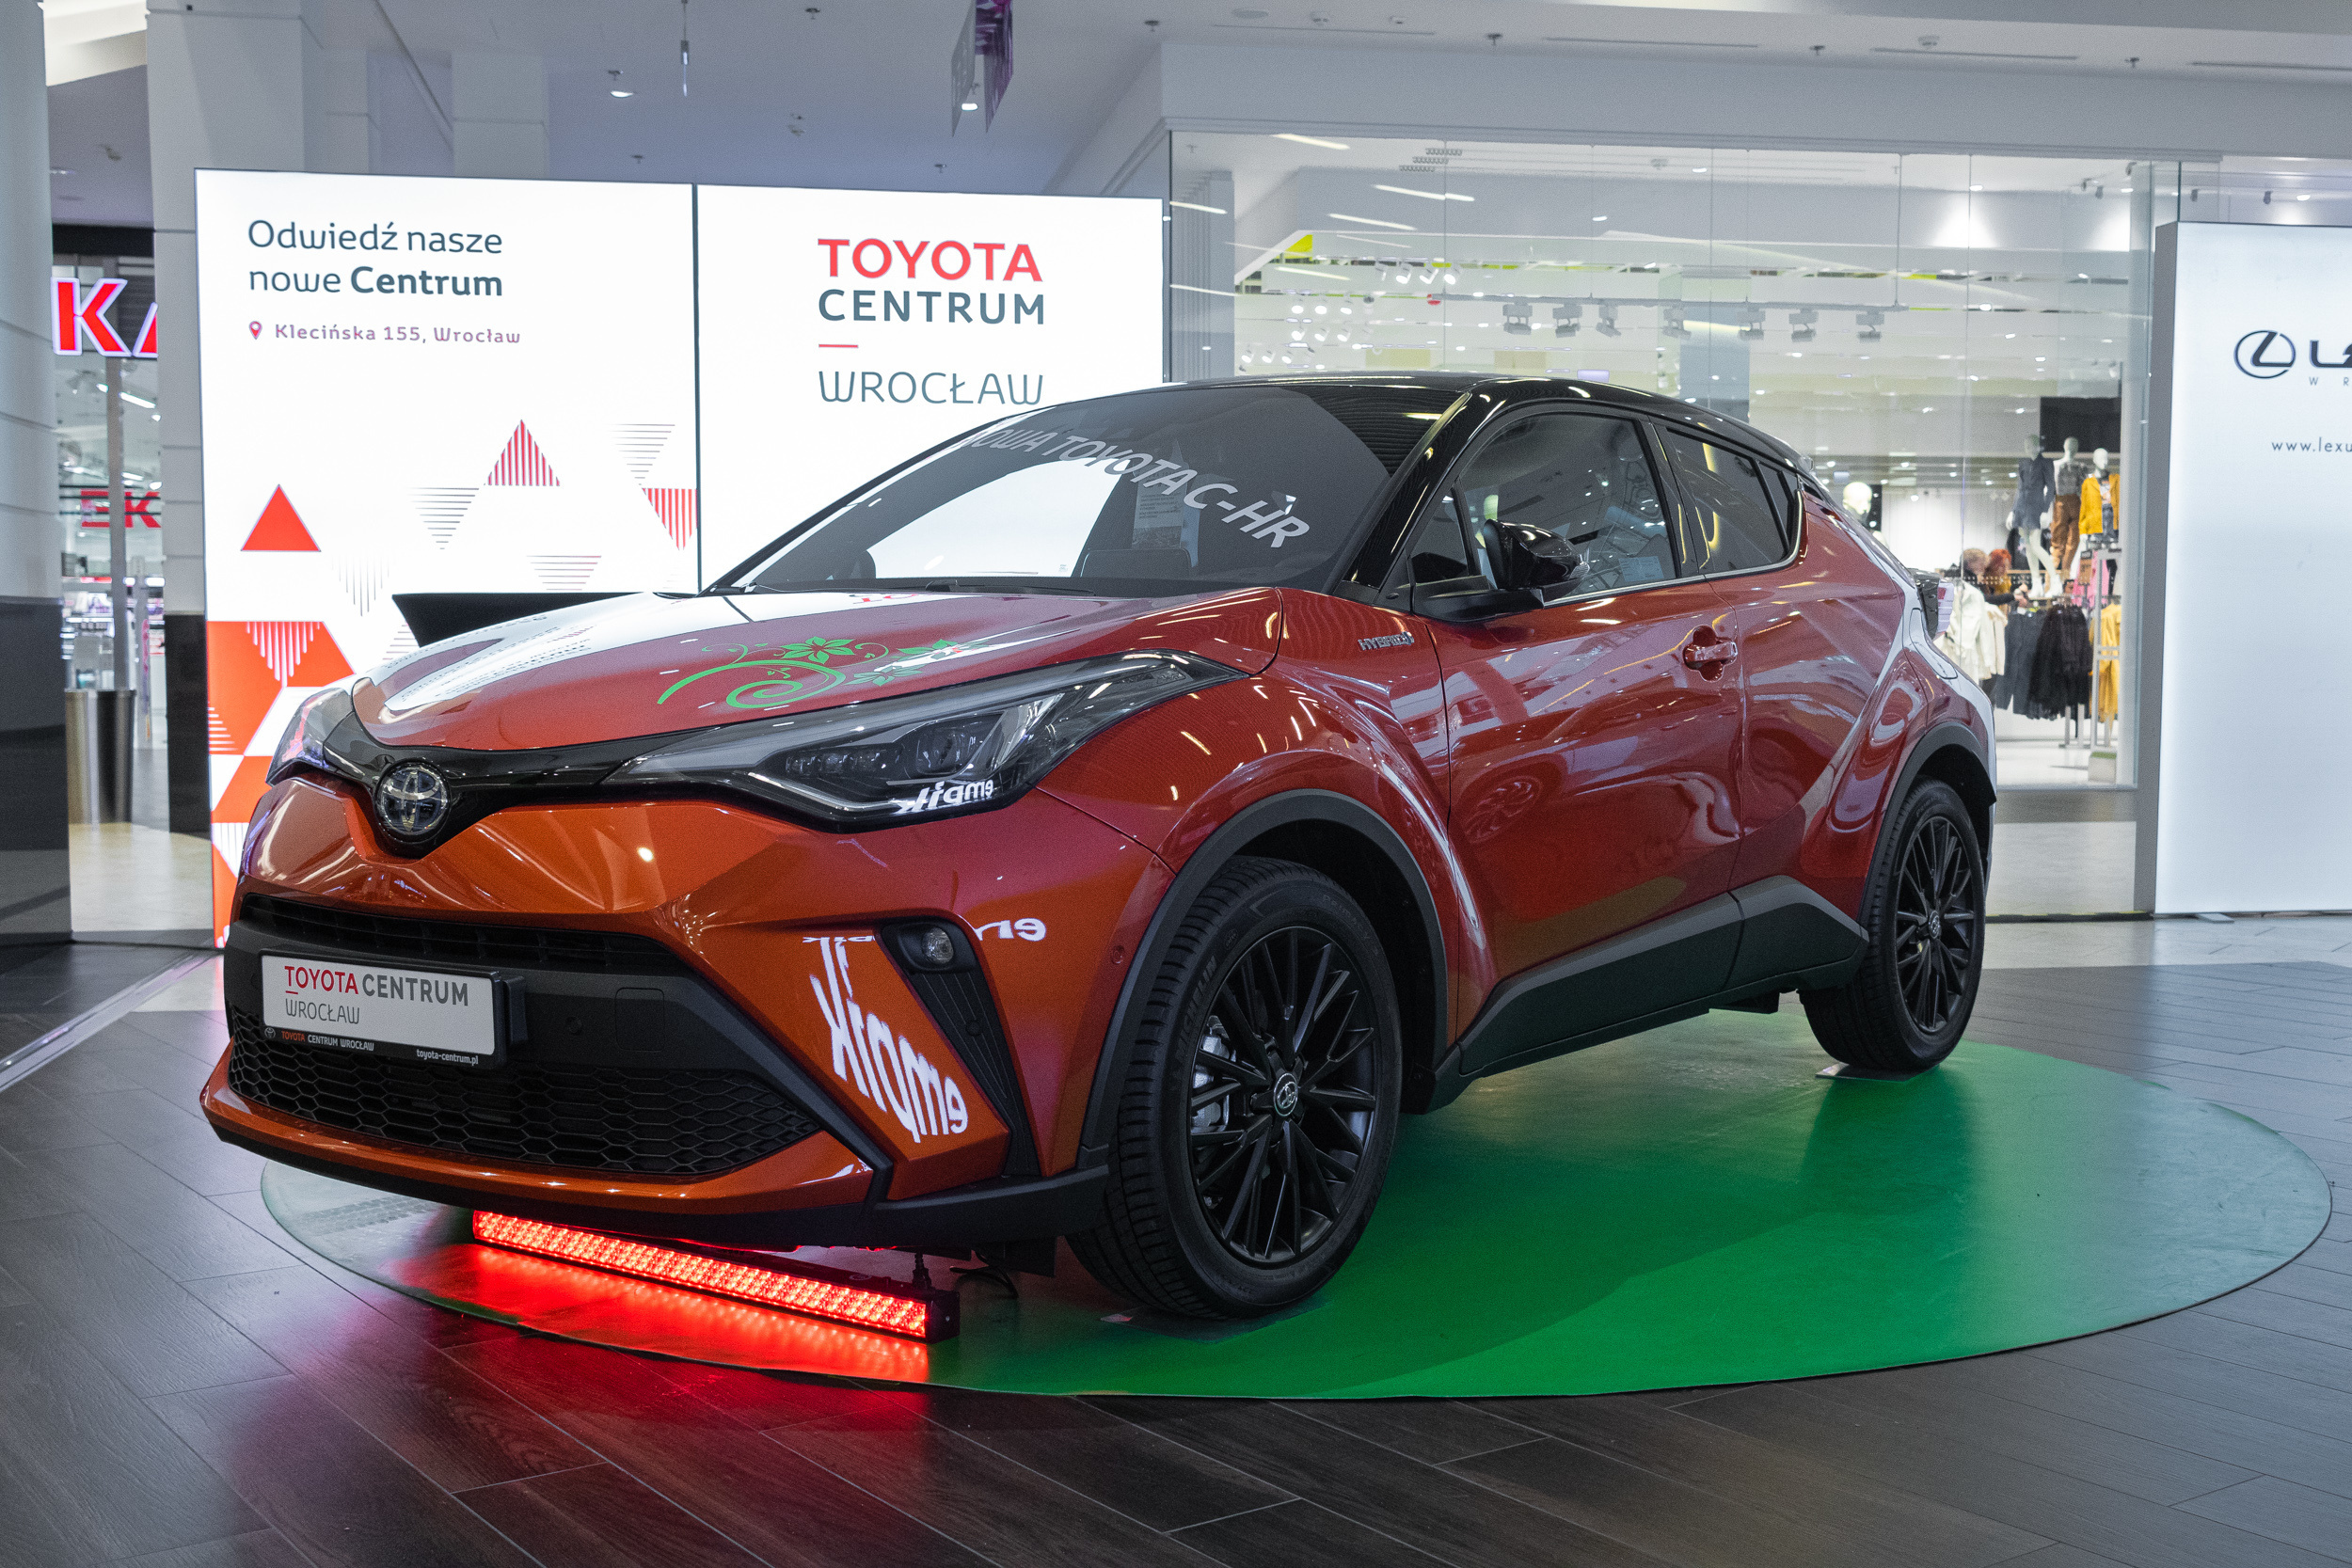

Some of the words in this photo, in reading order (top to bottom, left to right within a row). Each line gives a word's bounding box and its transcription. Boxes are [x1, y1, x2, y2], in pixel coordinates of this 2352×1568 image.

[248, 219, 398, 250] Odwiedź
[407, 230, 503, 254] nasze
[818, 238, 1043, 282] TOYOTA
[249, 270, 342, 293] nowe
[351, 265, 503, 296] Centrum
[818, 289, 1043, 325] CENTRUM
[275, 324, 376, 341] Klecińska
[383, 326, 426, 344] 155,
[433, 327, 521, 344] Wrocław
[818, 371, 1043, 405] WROCŁAW
[961, 429, 1060, 452] OWA
[1041, 435, 1198, 496] TOYOTA
[1183, 483, 1311, 548] C-HR
[1358, 633, 1408, 651] HYBRID
[284, 965, 359, 995] TOYOTA
[362, 974, 469, 1006] CENTRUM
[285, 998, 360, 1025] WROCŁAW
[281, 1030, 306, 1043] TOYOTA
[308, 1034, 339, 1048] CENTRUM
[340, 1037, 374, 1052] WROCŁAW
[416, 1048, 479, 1066] toyota-centrum.pl
